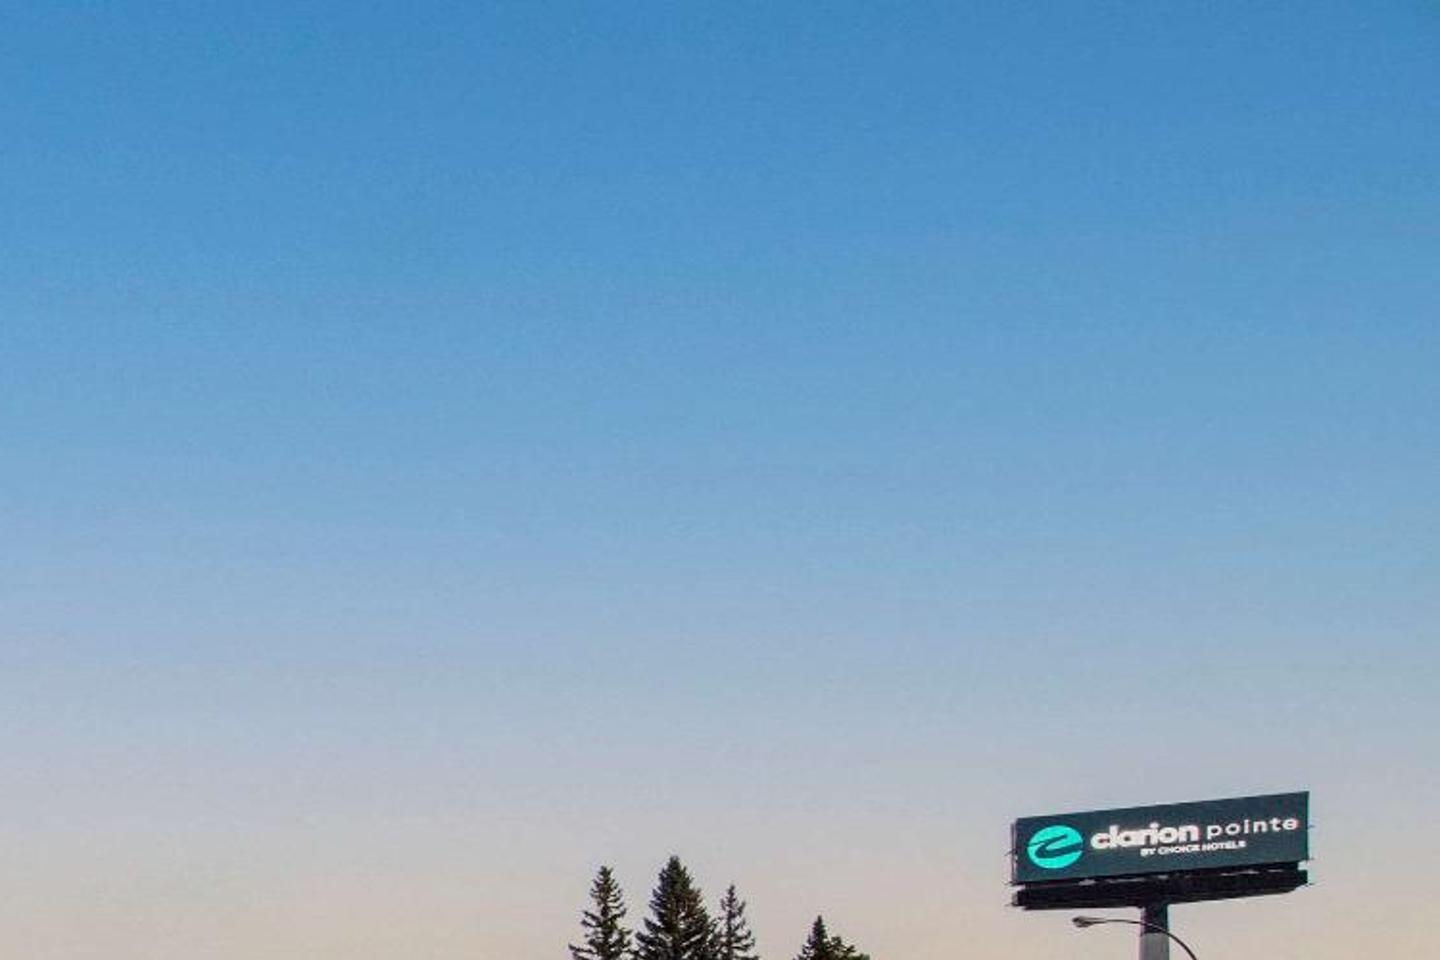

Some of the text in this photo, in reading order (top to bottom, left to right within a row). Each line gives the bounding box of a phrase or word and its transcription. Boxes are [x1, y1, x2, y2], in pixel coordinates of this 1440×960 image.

[1090, 816, 1299, 849] clarion pointe
[1159, 843, 1200, 855] CHOICE
[1202, 840, 1246, 851] HOTELS
